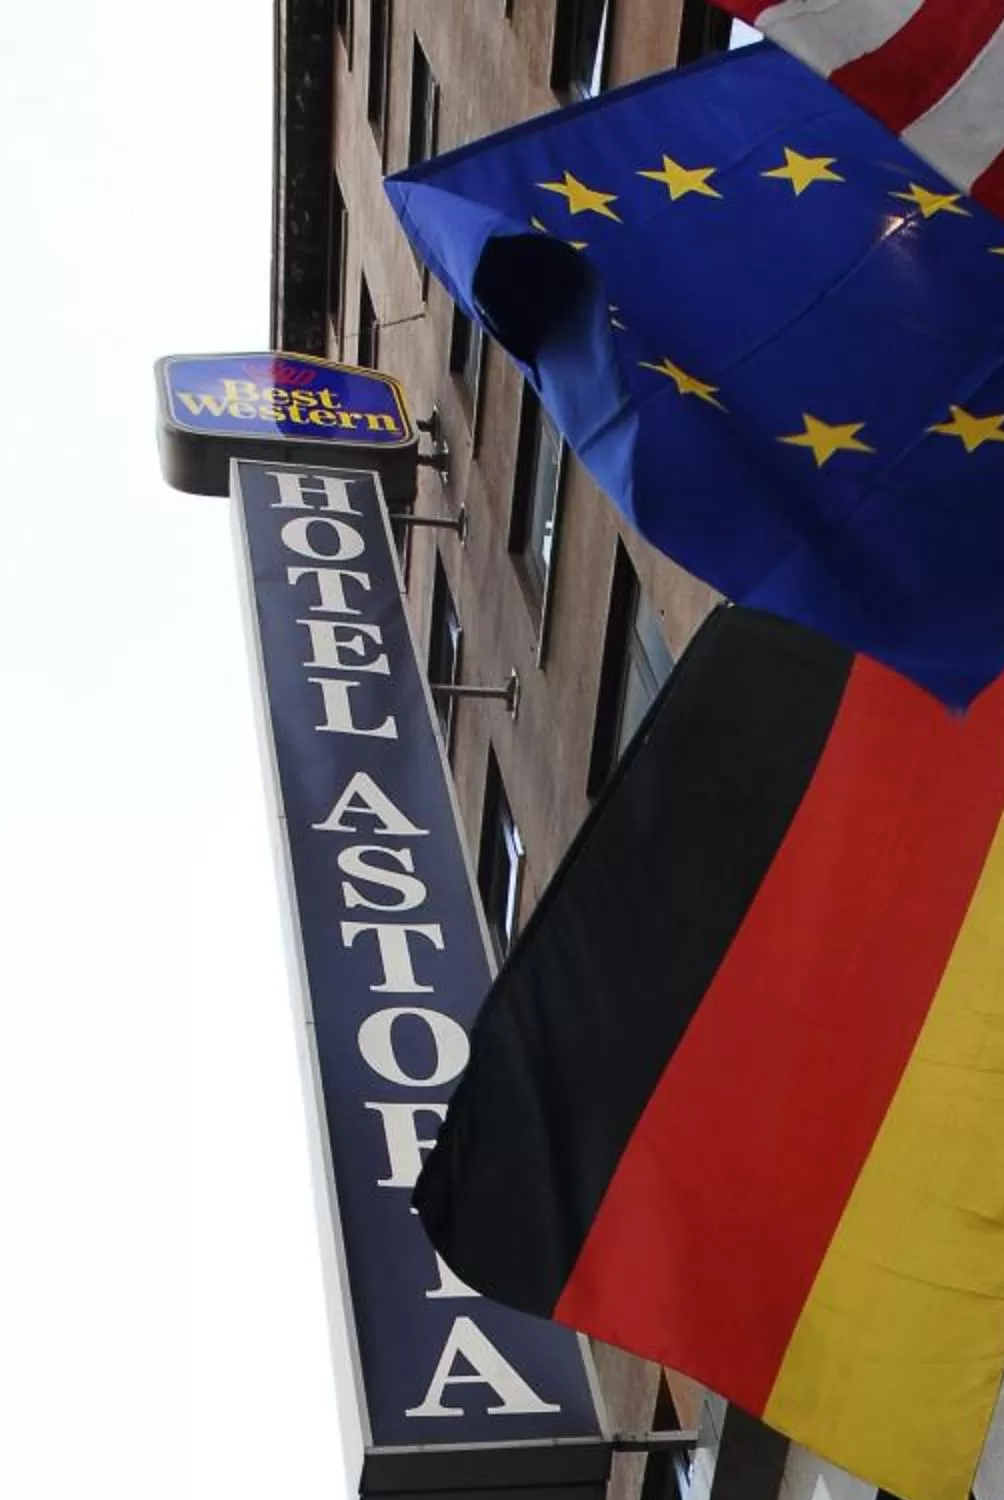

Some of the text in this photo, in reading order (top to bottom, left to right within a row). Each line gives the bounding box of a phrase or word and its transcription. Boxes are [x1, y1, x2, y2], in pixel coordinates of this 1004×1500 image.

[175, 391, 400, 432] Western
[220, 378, 341, 409] Best
[266, 471, 398, 739] HOTEL
